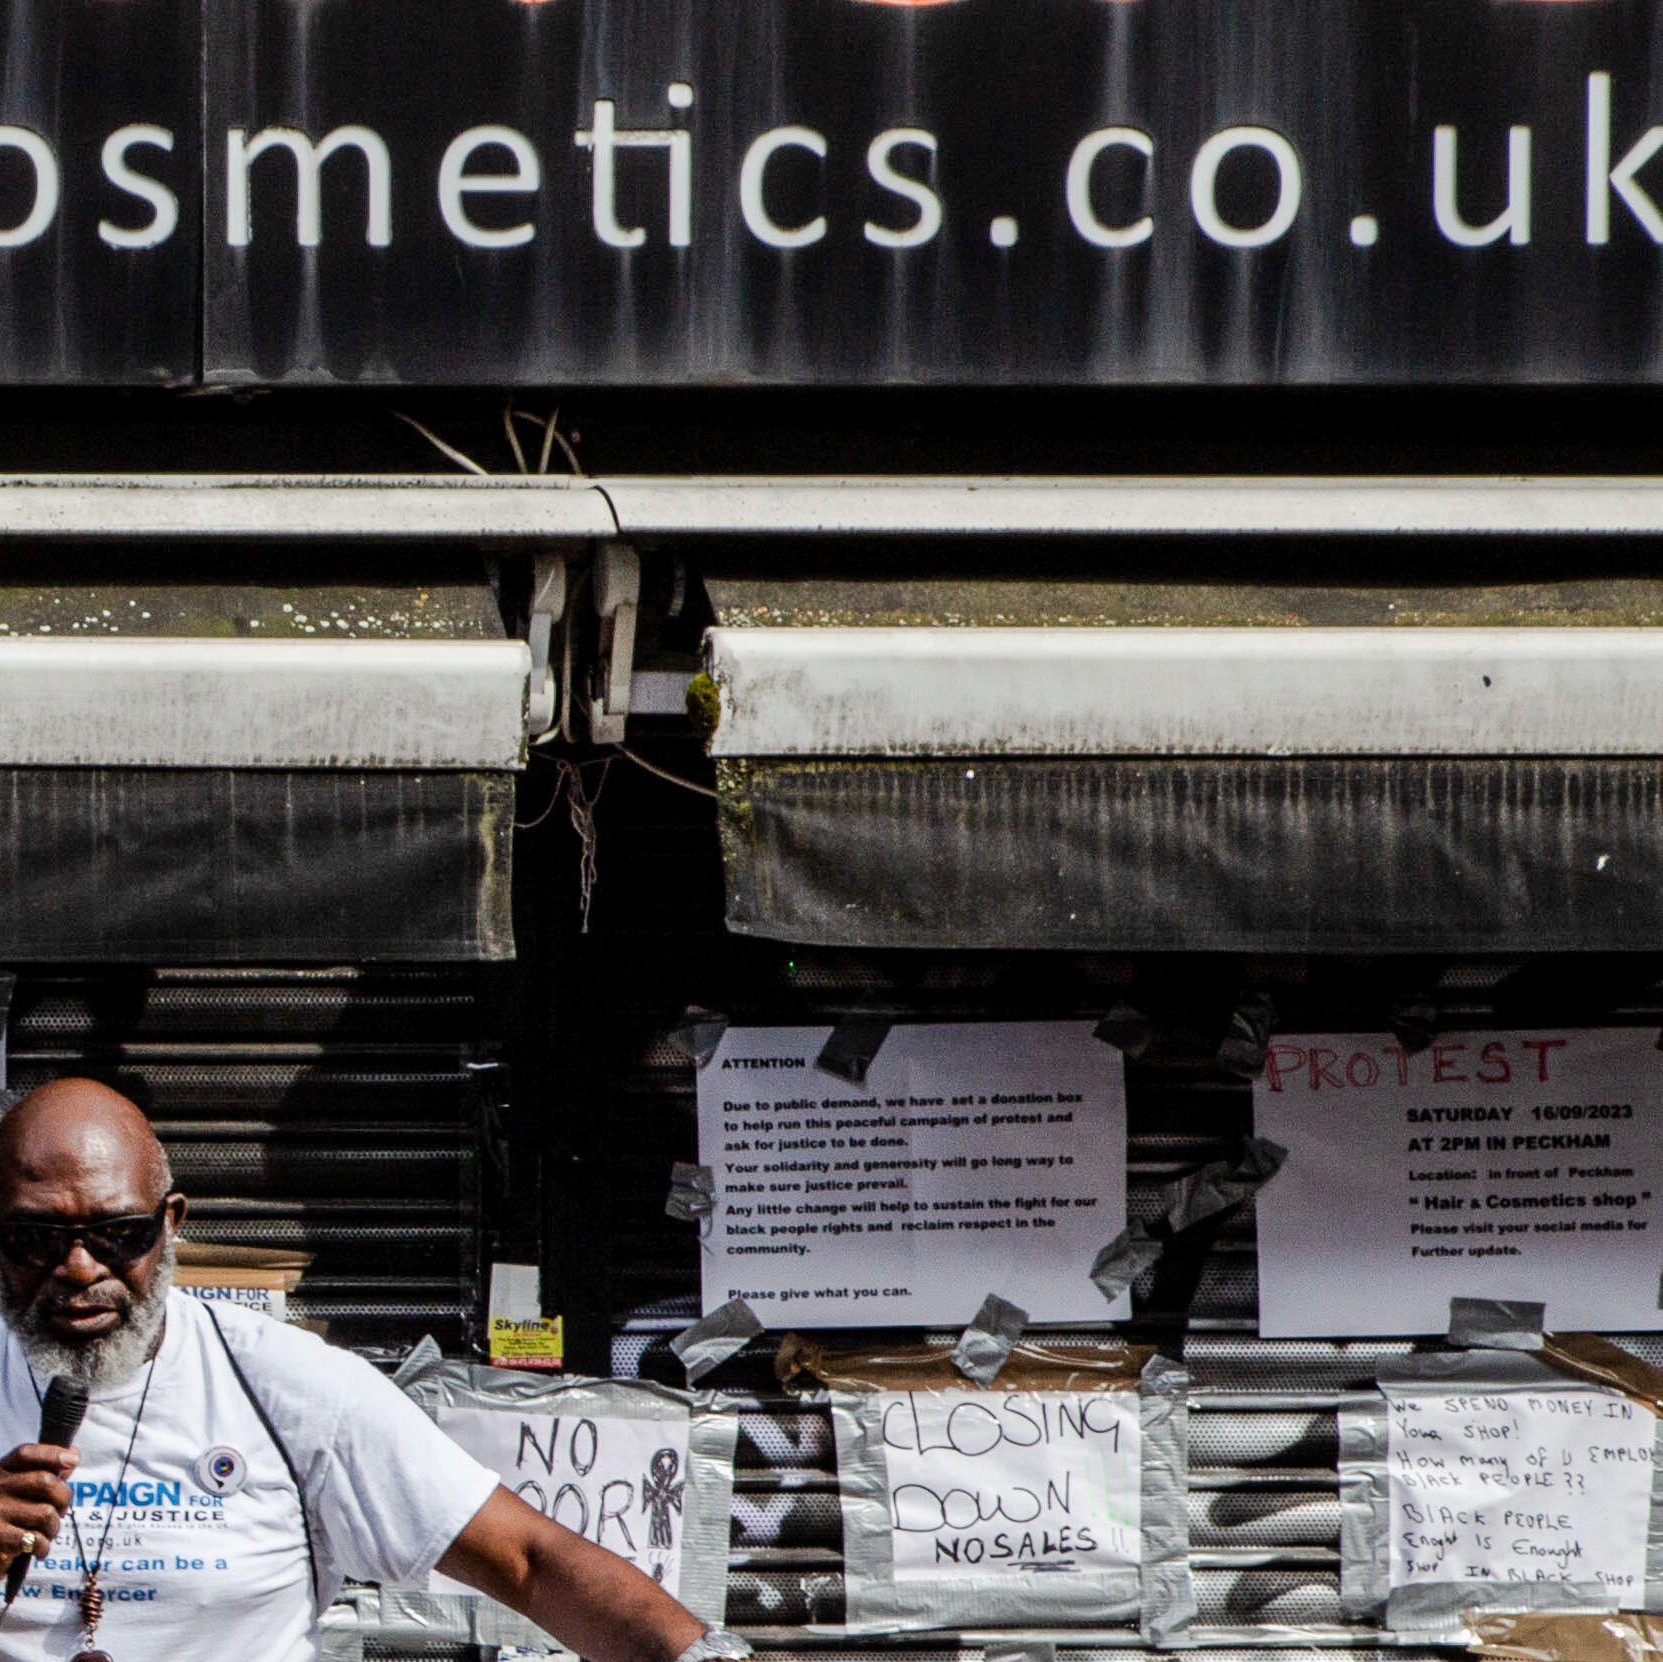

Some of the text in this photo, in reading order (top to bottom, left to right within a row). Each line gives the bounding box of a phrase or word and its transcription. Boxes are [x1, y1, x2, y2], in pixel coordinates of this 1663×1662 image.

[722, 1058, 805, 1069] ATTENTION
[1266, 1039, 1566, 1092] PROTEST
[1407, 1105, 1633, 1122] SATURDAY 16/09/2023
[725, 1137, 908, 1152] ask for justice to be done.
[1408, 1134, 1611, 1151] AT 2PM IN PECKHAM
[1506, 1167, 1539, 1178] front
[1544, 1167, 1559, 1178] of
[1569, 1167, 1634, 1178] Peckham
[1424, 1195, 1464, 1210] Hair
[1486, 1193, 1586, 1209] Cosmetics
[1592, 1193, 1636, 1209] shop
[1411, 1220, 1647, 1235] Please visit your social media for
[726, 1243, 810, 1256] community.
[1411, 1245, 1522, 1258] Further update.
[236, 1287, 269, 1300] FOR
[728, 1288, 912, 1301] Please give what you can.
[495, 1319, 550, 1332] Skyline
[883, 1391, 1120, 1456] CLOSING
[516, 1418, 598, 1477] NO
[189, 1494, 223, 1507] FOR
[892, 1471, 1071, 1532] DOWN
[88, 1510, 225, 1522] & JUSTICE
[121, 1555, 227, 1572] can be a
